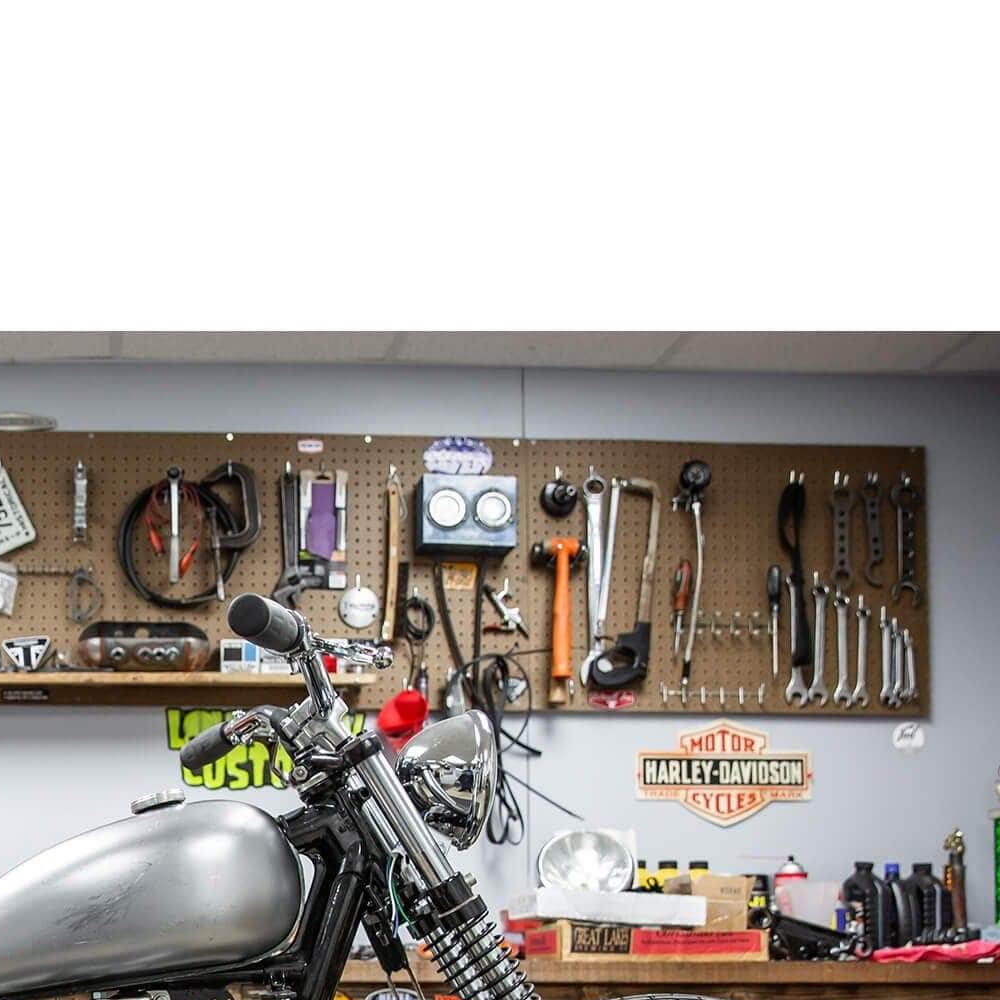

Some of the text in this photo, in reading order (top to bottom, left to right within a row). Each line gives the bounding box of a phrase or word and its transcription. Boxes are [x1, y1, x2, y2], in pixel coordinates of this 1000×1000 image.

[690, 729, 755, 752] MOTOR
[644, 759, 802, 785] HARLEY-DAVIDSON
[692, 792, 756, 814] CYCLES
[573, 926, 629, 945] GREAT LAKES
